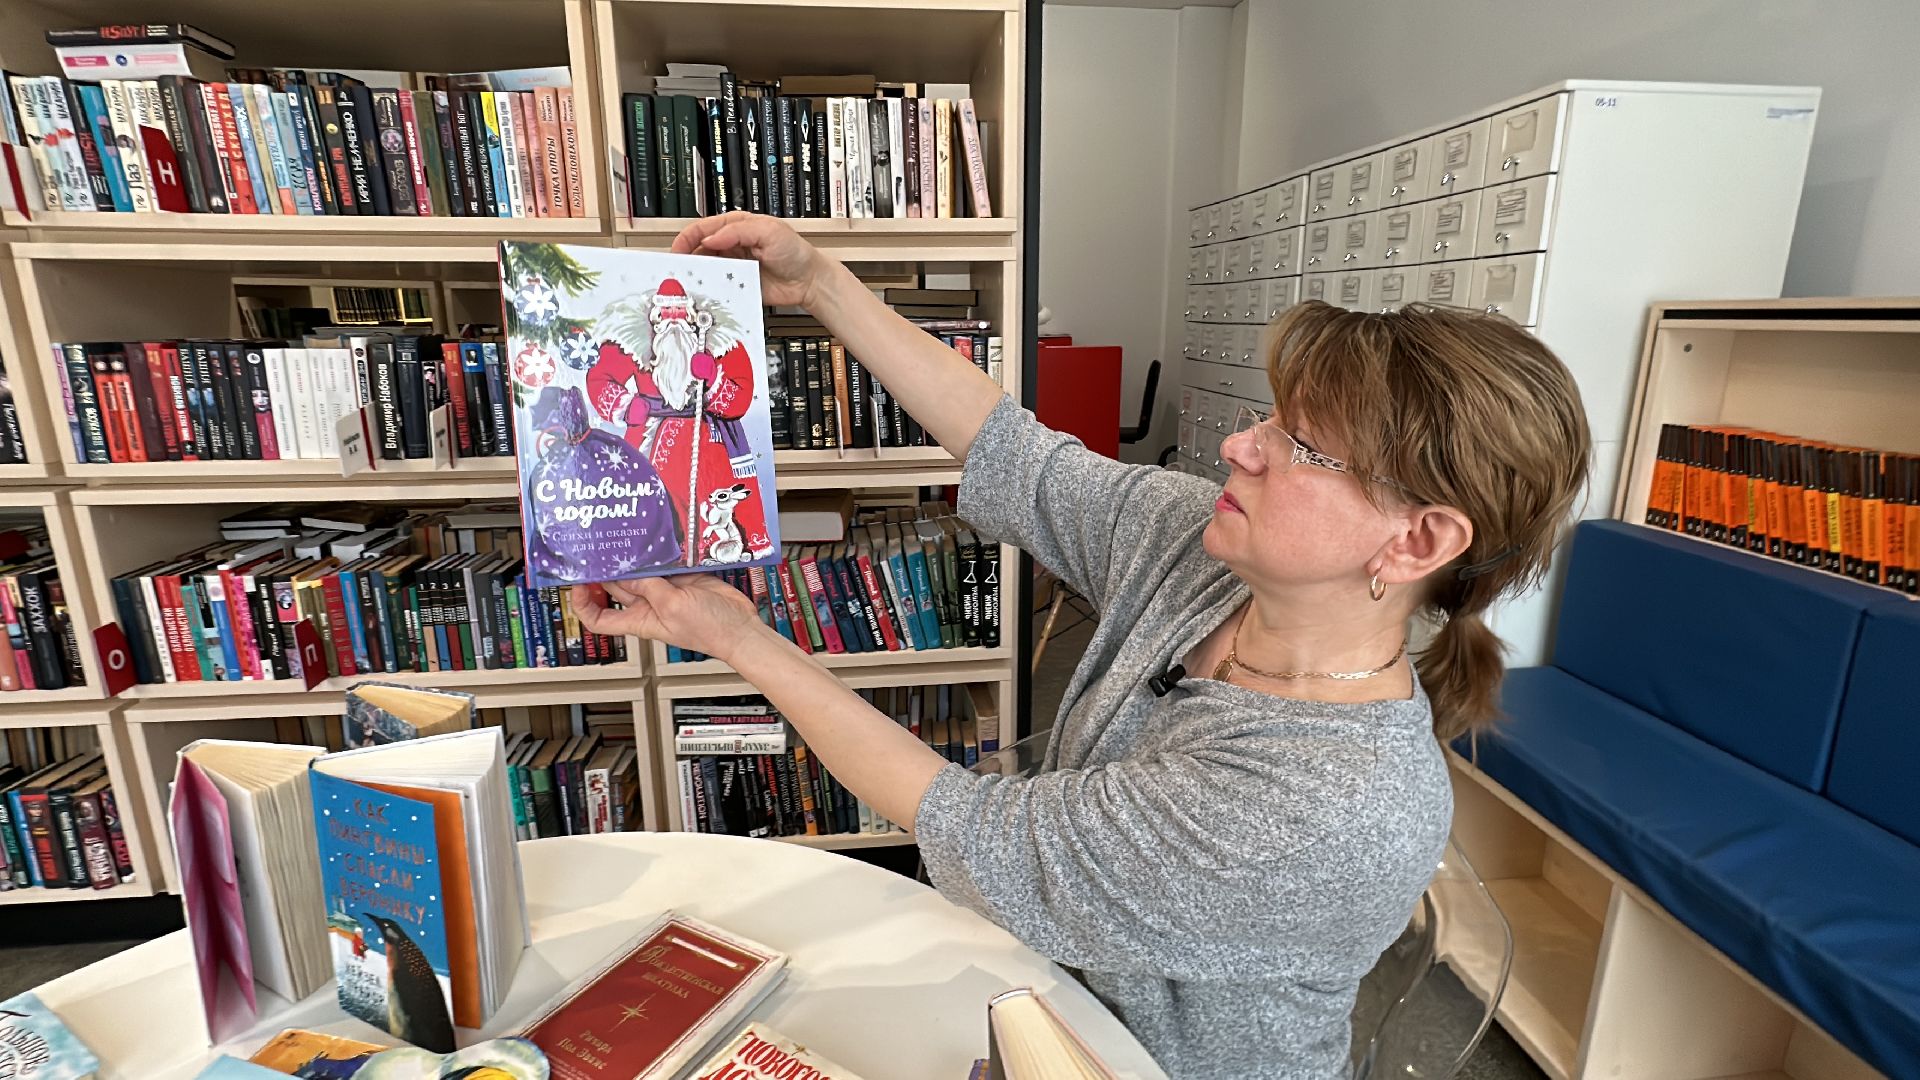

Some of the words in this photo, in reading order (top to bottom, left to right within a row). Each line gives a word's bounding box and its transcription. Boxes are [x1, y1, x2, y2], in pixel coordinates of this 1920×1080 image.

[723, 82, 736, 122] Пелевин
[217, 92, 242, 159] СКИНХЕД
[405, 121, 417, 147] НОСОВ
[343, 112, 364, 171] НЕМЧЕНКО
[547, 137, 560, 174] ОПОРЫ
[566, 128, 579, 184] ЧЕЛОВЕКОМ
[127, 163, 145, 190] Лаз
[157, 158, 177, 187] Н
[552, 176, 563, 208] ТОЧКА
[571, 185, 581, 208] БУДЬ
[376, 363, 391, 402] Набоков
[851, 361, 861, 402] ПИЛЬНЯК
[382, 403, 398, 450] Владимир
[493, 403, 507, 440] НАГИБИН
[854, 403, 862, 427] Борис
[498, 441, 508, 452] Ю.
[536, 479, 557, 502] С
[560, 476, 654, 501] Новым
[553, 497, 639, 529] годом!
[552, 530, 592, 542] Стихи
[595, 531, 603, 539] и
[606, 527, 648, 538] сказки
[572, 543, 595, 553] для
[598, 537, 632, 551] детей
[430, 582, 436, 590] 2
[442, 582, 449, 590] 3
[24, 586, 48, 633] ЗАХХОК
[162, 607, 182, 652] ОХЛОБЫСТИН
[175, 607, 196, 652] ОХЛОБЫСТИН
[107, 648, 126, 671] О
[304, 642, 319, 667] П
[680, 743, 734, 752] ПРИЛЕПИН
[743, 743, 770, 752] ЗАХАР
[354, 799, 389, 825] КАК
[329, 818, 425, 865] ПИНГВИНЫ
[338, 877, 426, 926] ВЕРОНИКУ
